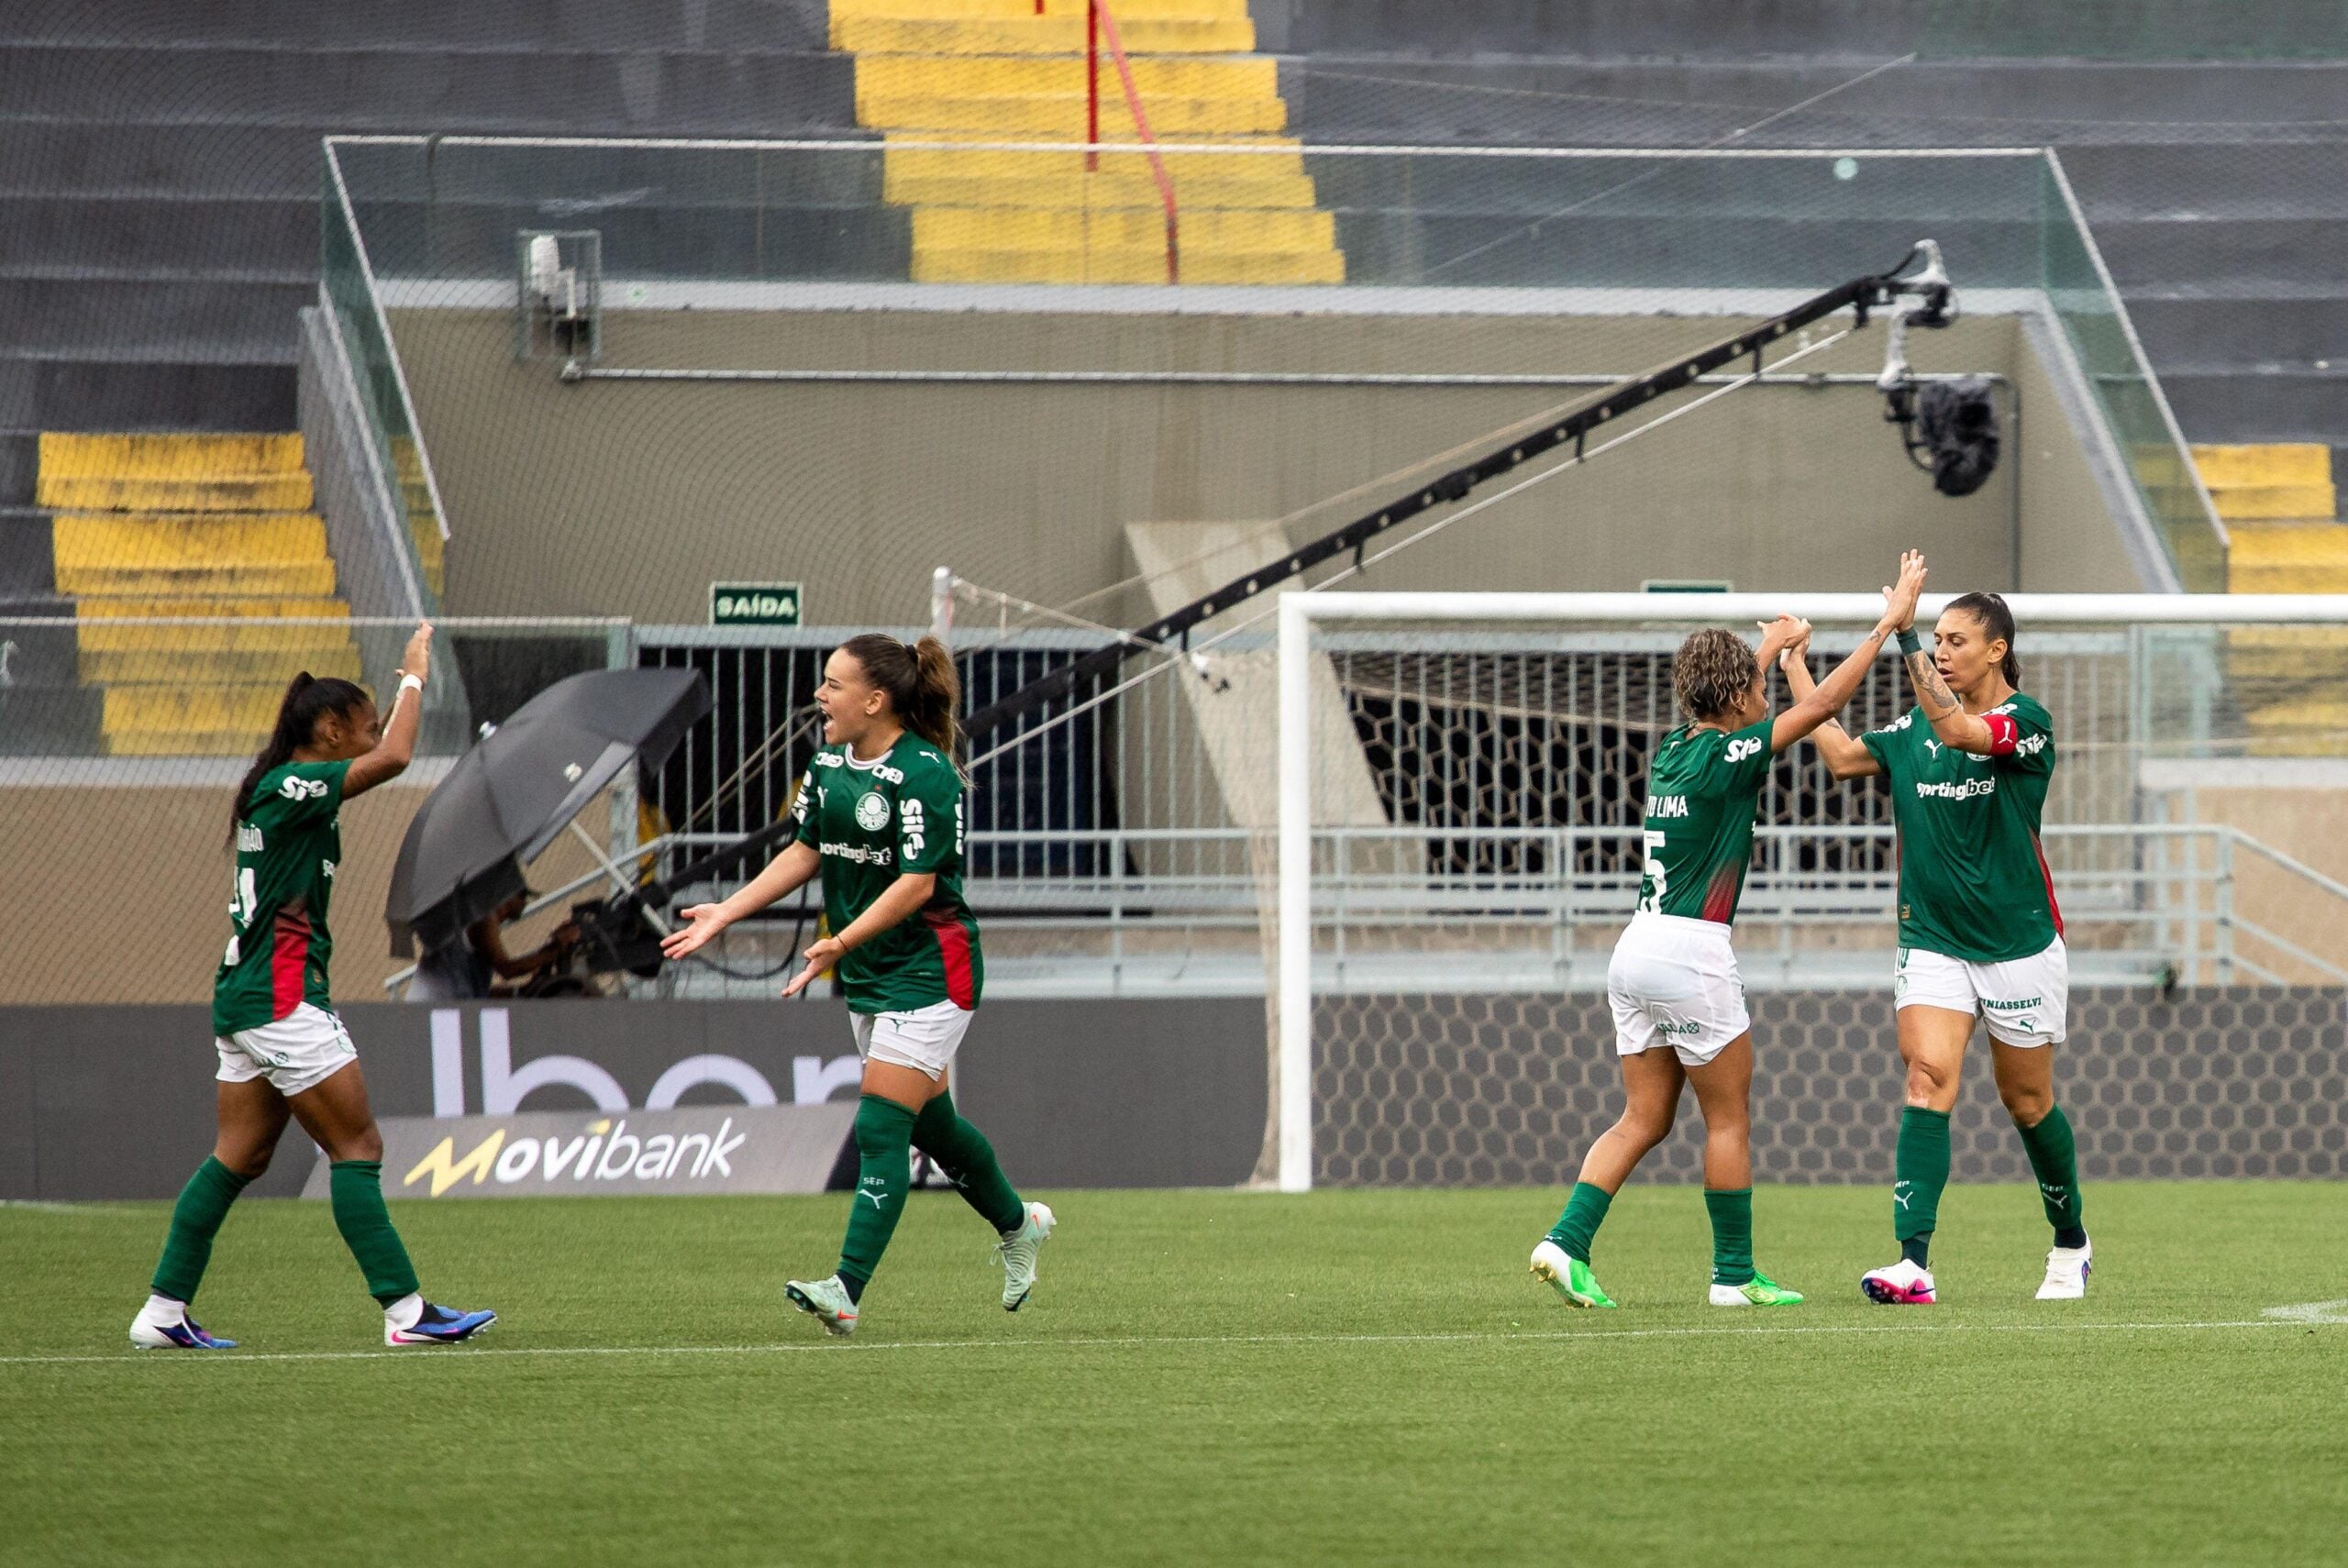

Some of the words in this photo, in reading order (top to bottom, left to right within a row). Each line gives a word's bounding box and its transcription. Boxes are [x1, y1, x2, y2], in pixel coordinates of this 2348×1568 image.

[716, 592, 796, 618] SAÍDA
[1656, 795, 1689, 818] LIMA
[403, 1117, 747, 1198] Movibank
